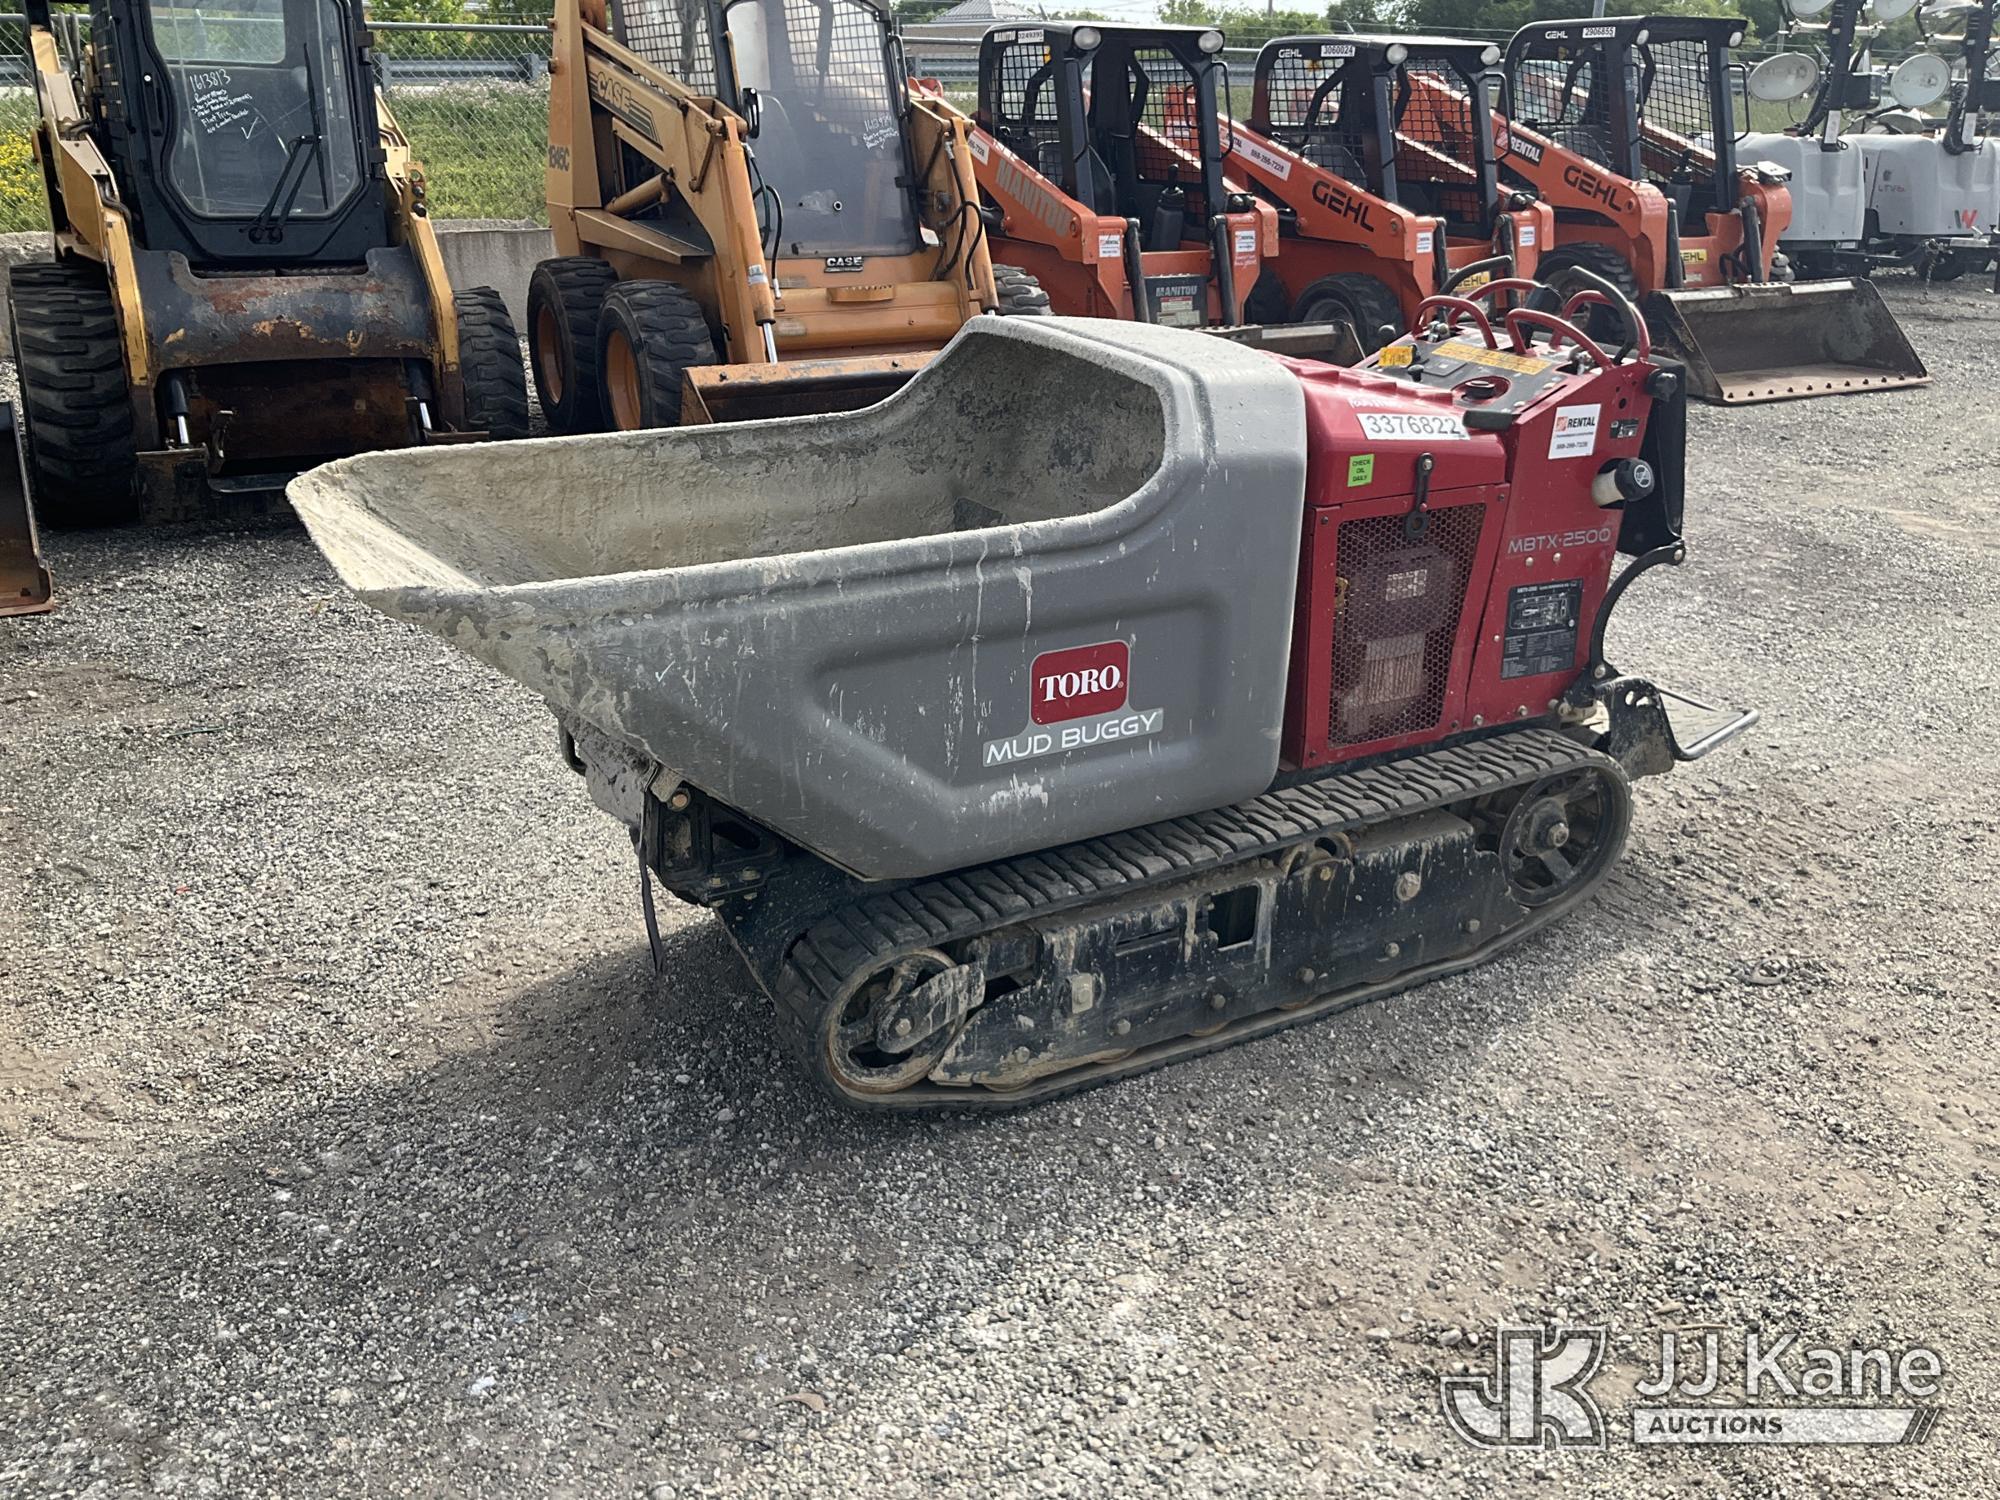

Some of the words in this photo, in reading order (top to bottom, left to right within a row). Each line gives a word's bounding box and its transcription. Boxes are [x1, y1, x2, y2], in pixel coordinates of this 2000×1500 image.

[1544, 30, 1568, 39] GEHL
[1278, 49, 1302, 58] GEHL
[190, 69, 230, 92] 1613813
[597, 71, 631, 114] CASE
[996, 158, 1072, 237] MANITOU
[1563, 165, 1622, 212] GEHL
[1312, 180, 1375, 233] GEHL
[826, 256, 863, 267] CASE
[1679, 252, 1704, 261] EHL
[1156, 285, 1198, 297] MANITOU
[1366, 415, 1461, 435] 3376822
[1567, 416, 1596, 429] RENTAL
[1040, 665, 1120, 702] TORO
[986, 733, 1052, 764] MUD
[1061, 711, 1158, 749] BUGGY
